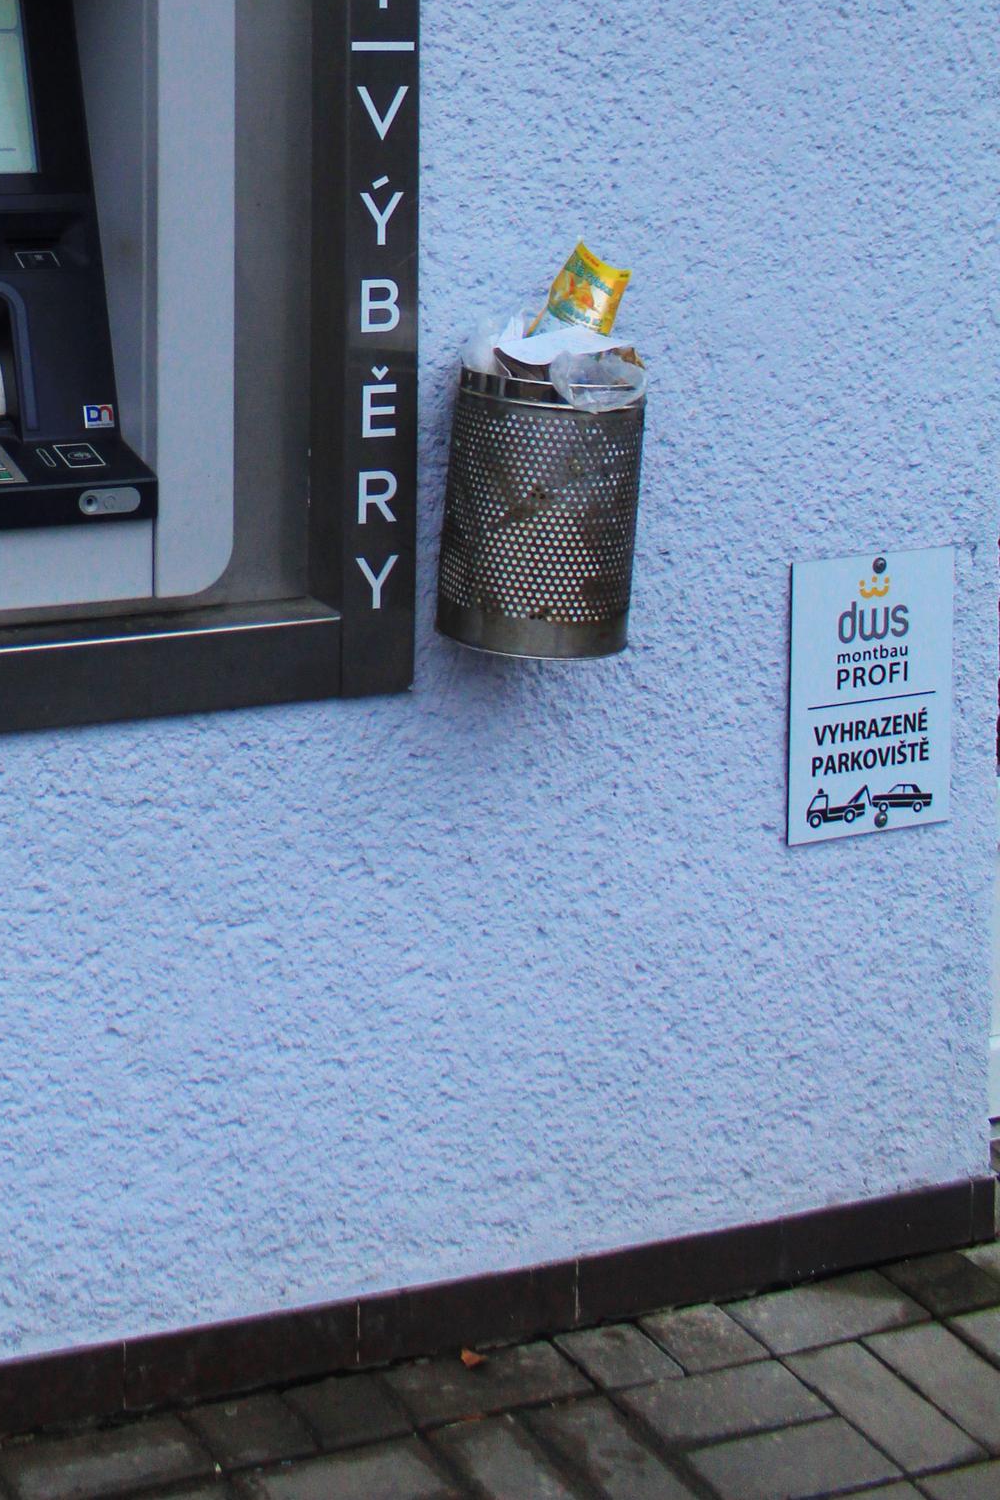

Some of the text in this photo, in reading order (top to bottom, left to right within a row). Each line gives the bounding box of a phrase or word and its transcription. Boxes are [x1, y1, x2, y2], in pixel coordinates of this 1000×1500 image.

[355, 85, 409, 609] VÝBĚRY
[837, 601, 910, 645] dws
[836, 644, 909, 665] montbau
[836, 660, 909, 690] PROFI
[813, 707, 929, 746] VYHRAZENÉ
[811, 736, 930, 778] PARKOVIŠTĚ
